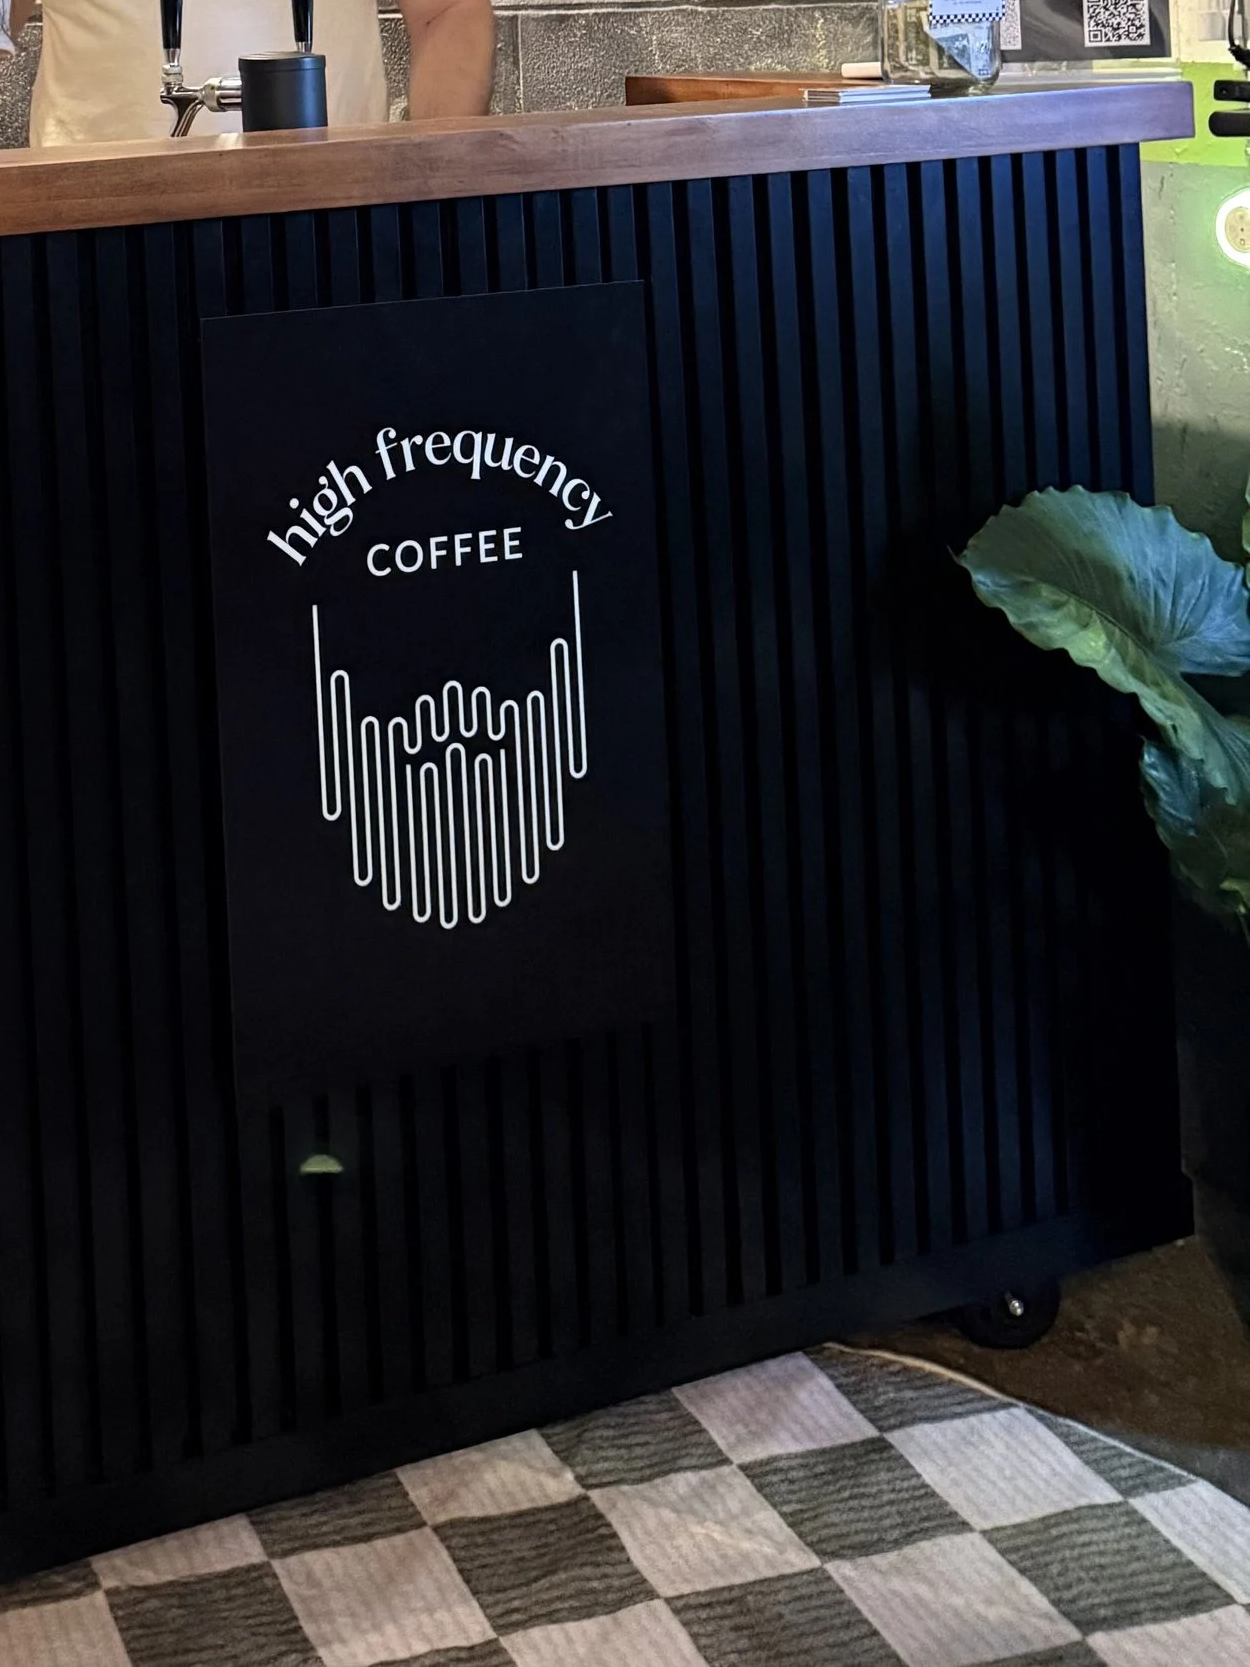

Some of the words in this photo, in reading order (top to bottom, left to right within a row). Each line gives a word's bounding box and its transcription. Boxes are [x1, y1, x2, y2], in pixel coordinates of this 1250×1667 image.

[267, 459, 374, 567] high
[373, 426, 614, 531] frequency
[366, 526, 524, 577] COFFEE
